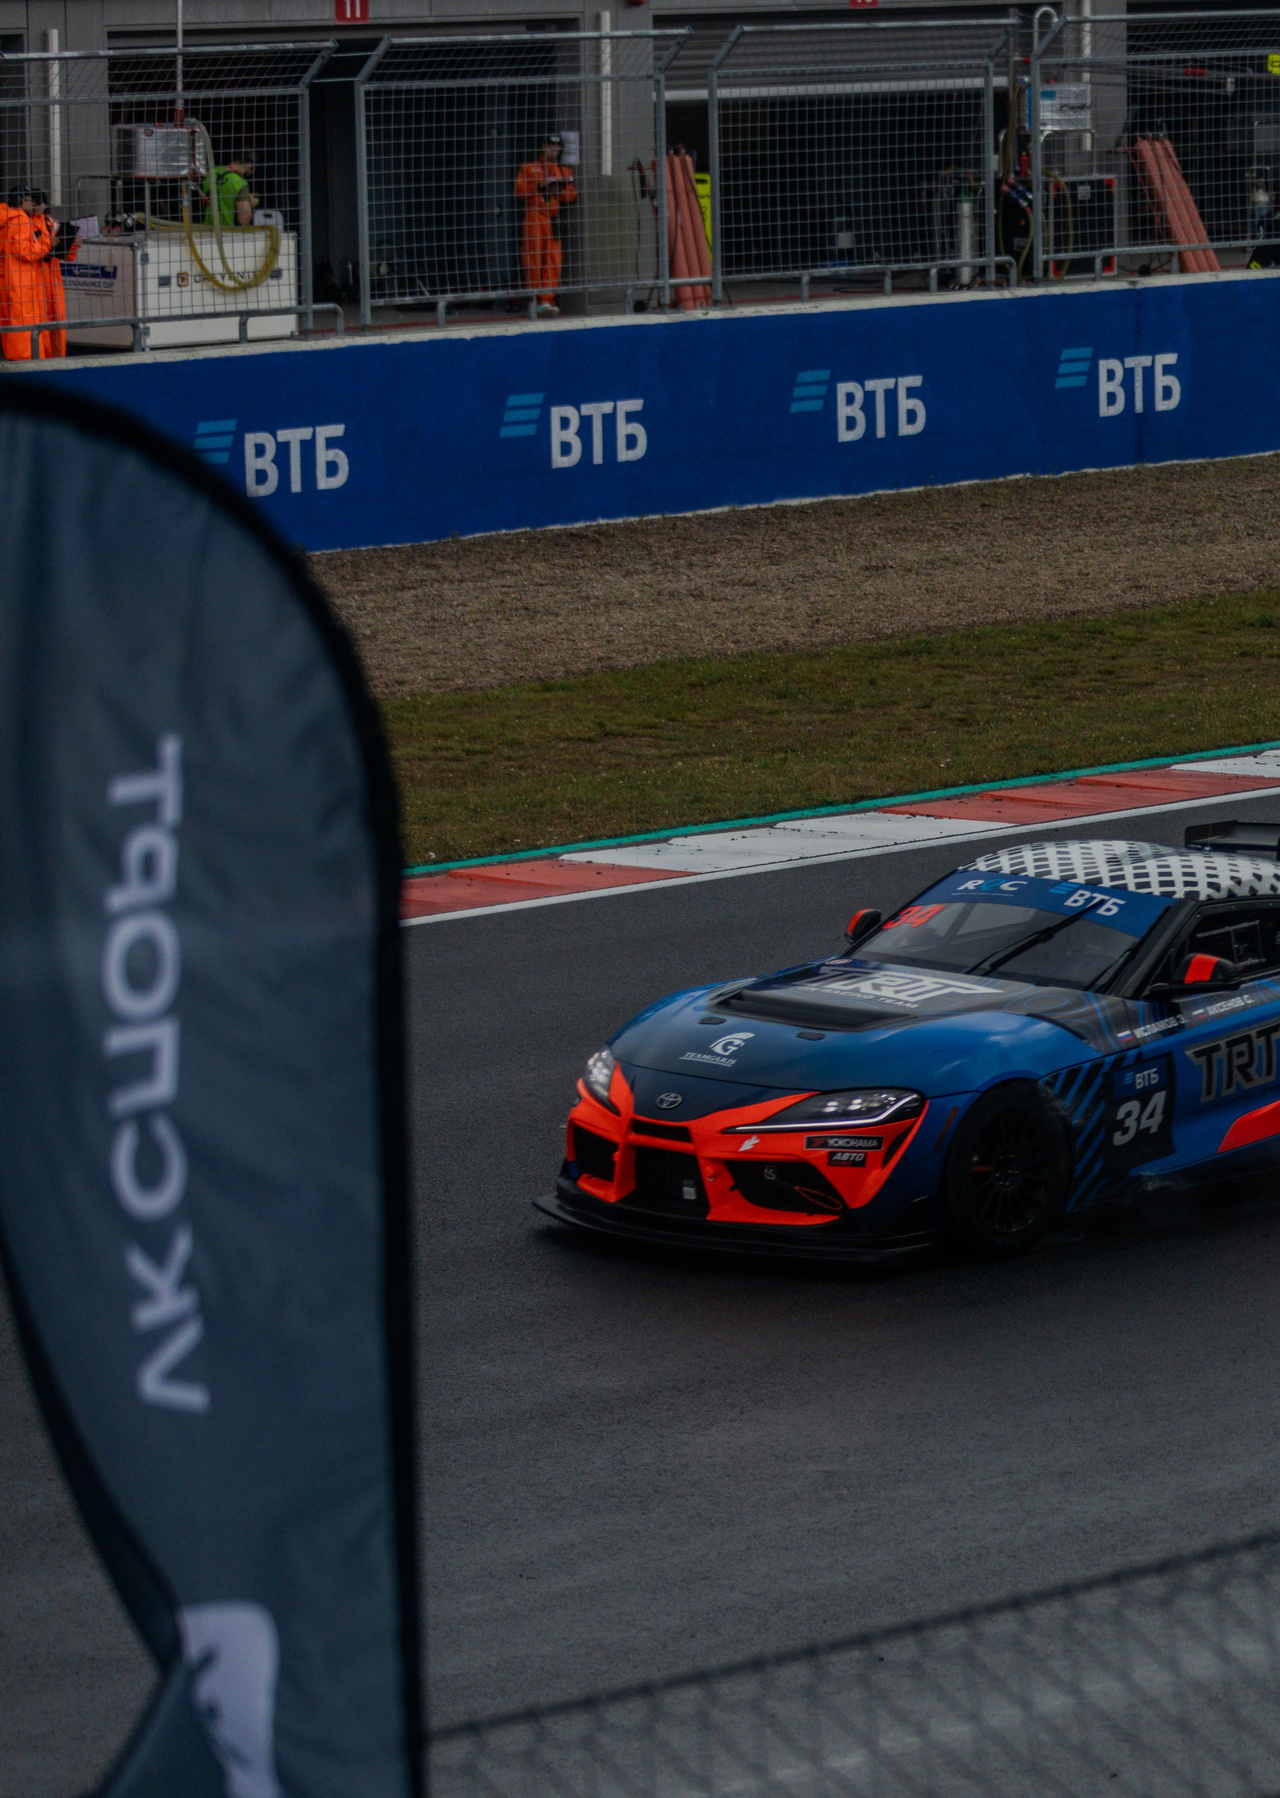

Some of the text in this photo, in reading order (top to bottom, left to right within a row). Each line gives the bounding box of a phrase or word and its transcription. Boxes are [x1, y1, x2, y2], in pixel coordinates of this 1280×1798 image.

[1099, 354, 1180, 416] ВТБ
[838, 376, 925, 441] ВТБ
[551, 400, 646, 468] ВТБ
[245, 425, 348, 495] ВТБ
[882, 904, 945, 930] 34
[1063, 889, 1128, 917] ВТБ
[1135, 1067, 1159, 1090] ВТБ
[1112, 1090, 1167, 1146] 34
[827, 1138, 878, 1148] YOKOHAMA
[831, 1152, 866, 1161] АВТО
